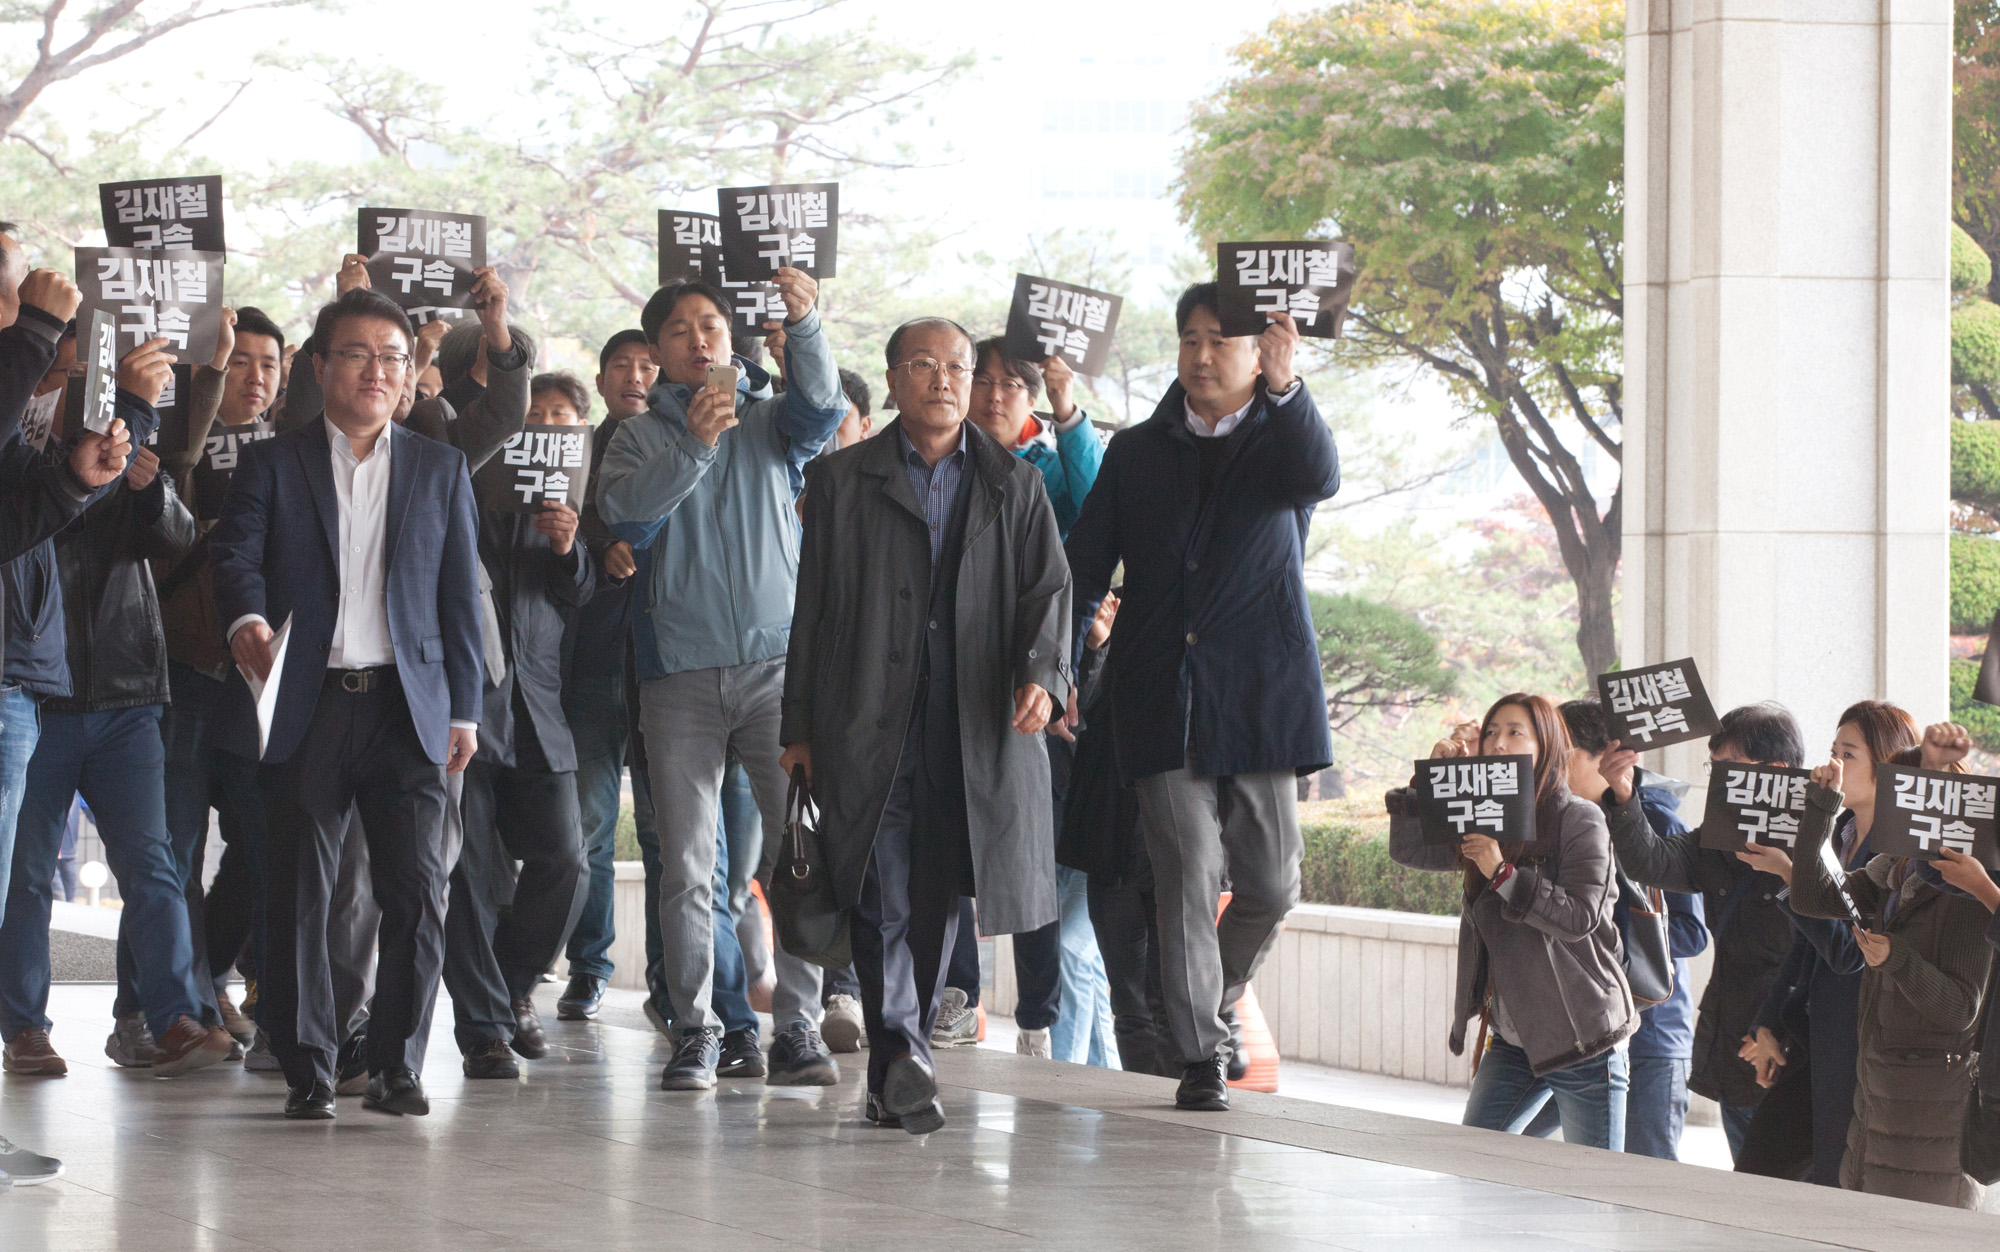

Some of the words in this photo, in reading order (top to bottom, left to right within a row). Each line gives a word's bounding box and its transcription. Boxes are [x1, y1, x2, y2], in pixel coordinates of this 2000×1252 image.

[114, 184, 208, 223] 김재철
[736, 192, 828, 231] 김재철
[376, 216, 472, 258] 김재철
[758, 232, 816, 270] 구속
[97, 257, 207, 303] 김재철
[391, 256, 455, 296] 구속
[1235, 249, 1338, 288] 김재철
[1028, 283, 1111, 333] 김재철
[1254, 288, 1321, 327] 구속
[121, 305, 190, 350] 구속
[1036, 321, 1090, 364] 구속
[503, 431, 585, 467] 김재철
[514, 469, 570, 505] 구속
[1607, 667, 1693, 714] 김재철
[1626, 706, 1690, 743] 구속
[1429, 761, 1519, 799] 김재철
[1894, 773, 1997, 820] 김재철
[1447, 799, 1504, 833] 구속
[1737, 808, 1800, 848] 구속
[1908, 813, 1976, 857] 구속
